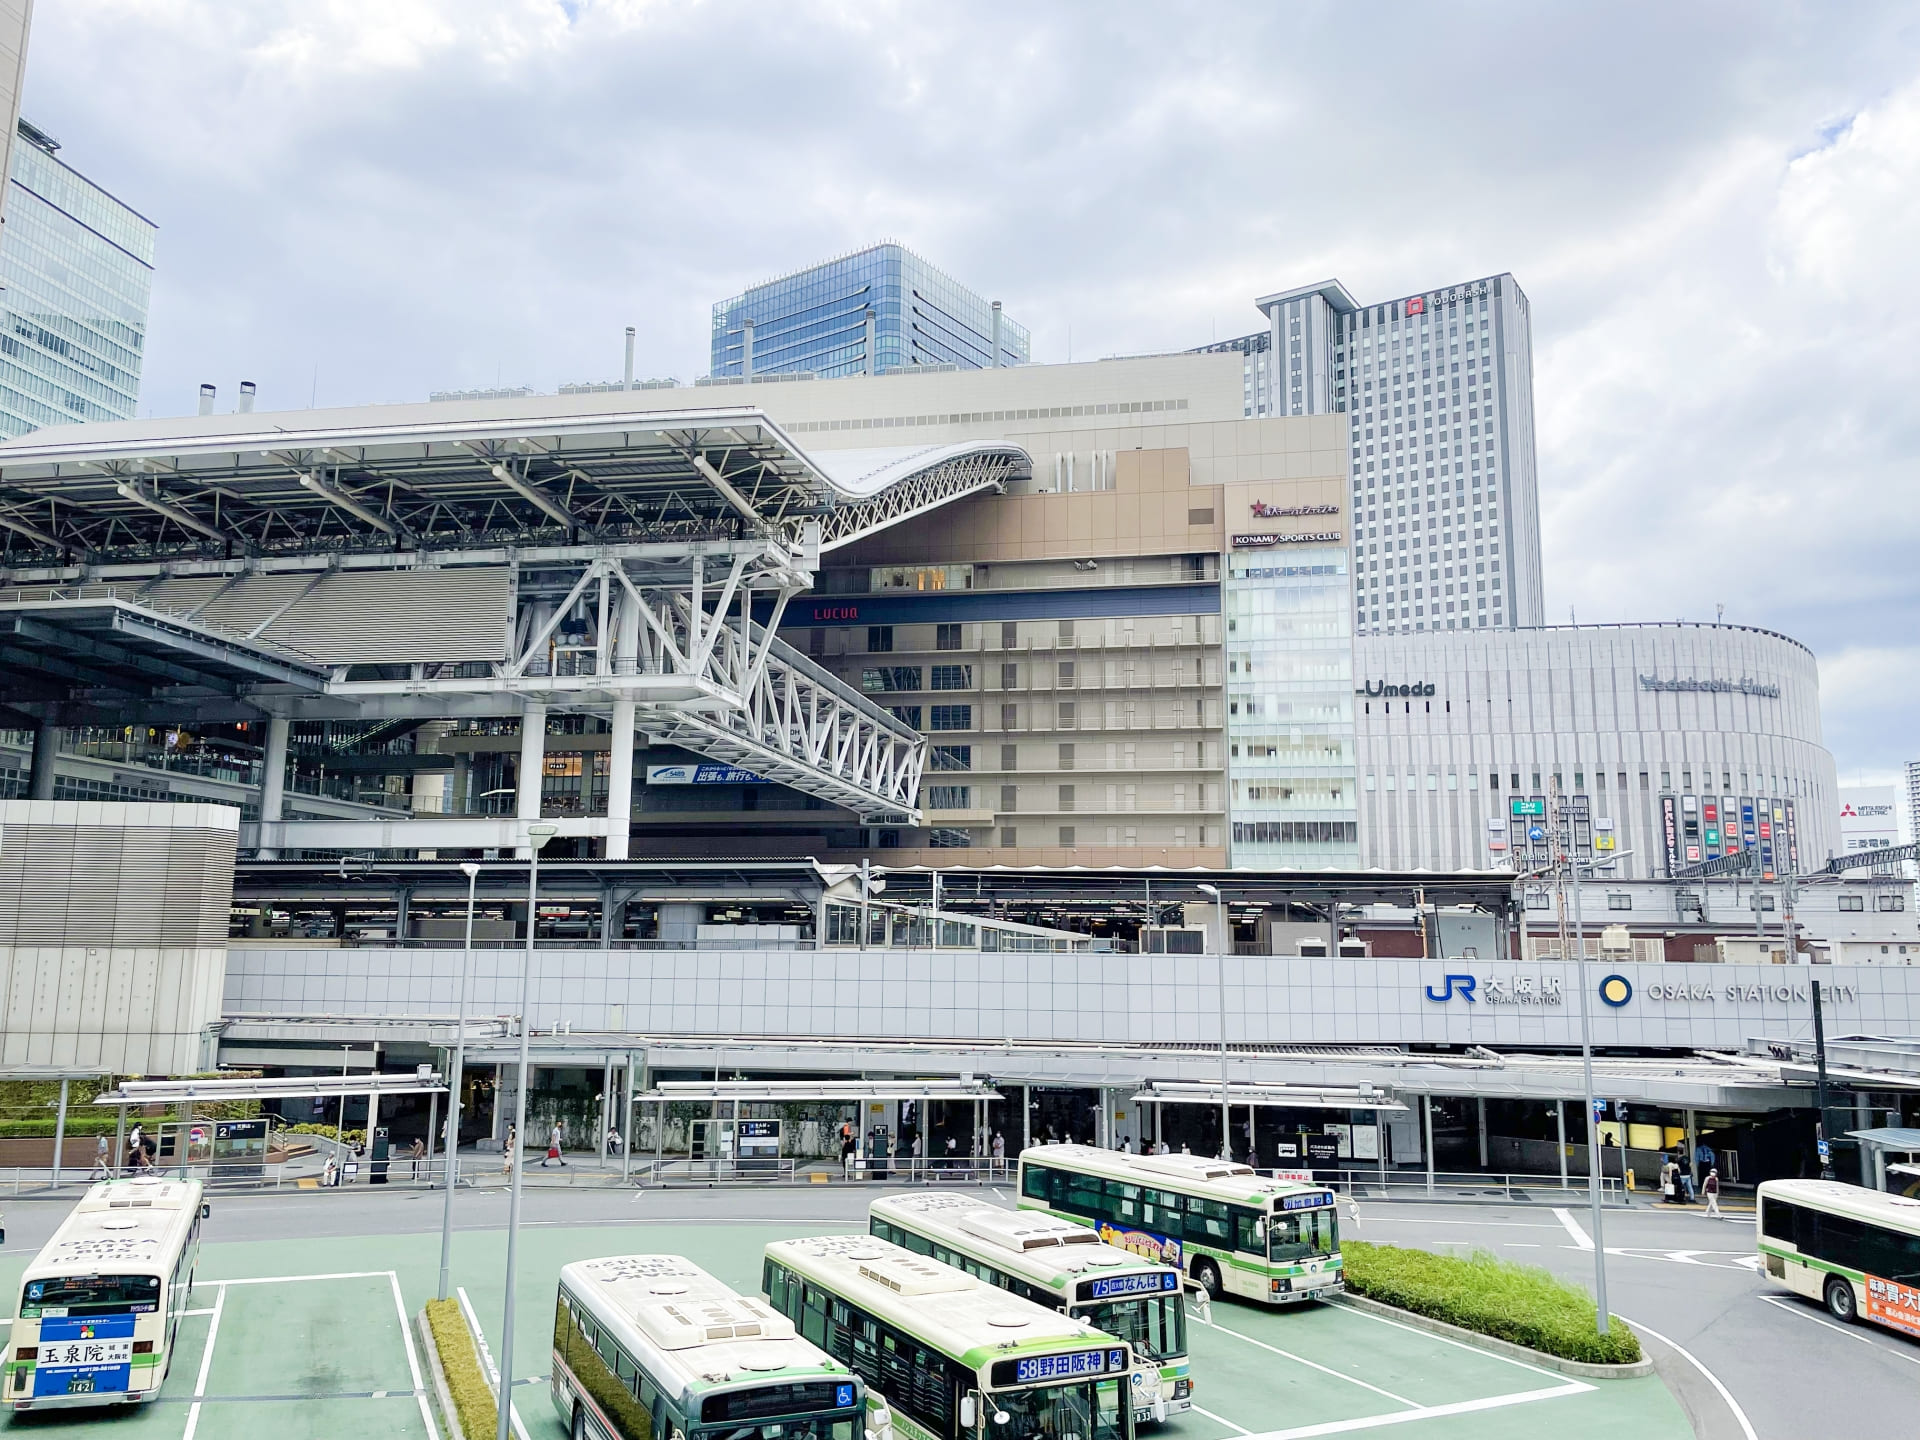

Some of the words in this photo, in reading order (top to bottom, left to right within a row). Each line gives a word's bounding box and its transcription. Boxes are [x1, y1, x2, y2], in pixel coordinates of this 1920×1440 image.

[1235, 535, 1274, 544] KONAMI
[1279, 533, 1316, 543] SPORTS
[1316, 532, 1342, 541] CLUB
[1426, 974, 1477, 1002] JR
[1484, 976, 1562, 995] 大阪駅
[1648, 983, 1715, 1001] OSAKA
[1726, 984, 1808, 1002] STATION
[1819, 984, 1858, 1003] CITY
[1485, 995, 1518, 1005] OSAKA
[1521, 995, 1562, 1005] STATION
[219, 1127, 228, 1137] 2
[741, 1125, 747, 1134] 1
[60, 1238, 159, 1247] OSAKA
[52, 1254, 152, 1263] 19-1421
[600, 1272, 698, 1283] OSAKA
[1125, 1275, 1158, 1291] なんば
[1093, 1280, 1109, 1297] 75
[41, 1344, 104, 1364] 玉泉院
[1018, 1358, 1039, 1379] 58
[1039, 1351, 1101, 1377] 野田阪神
